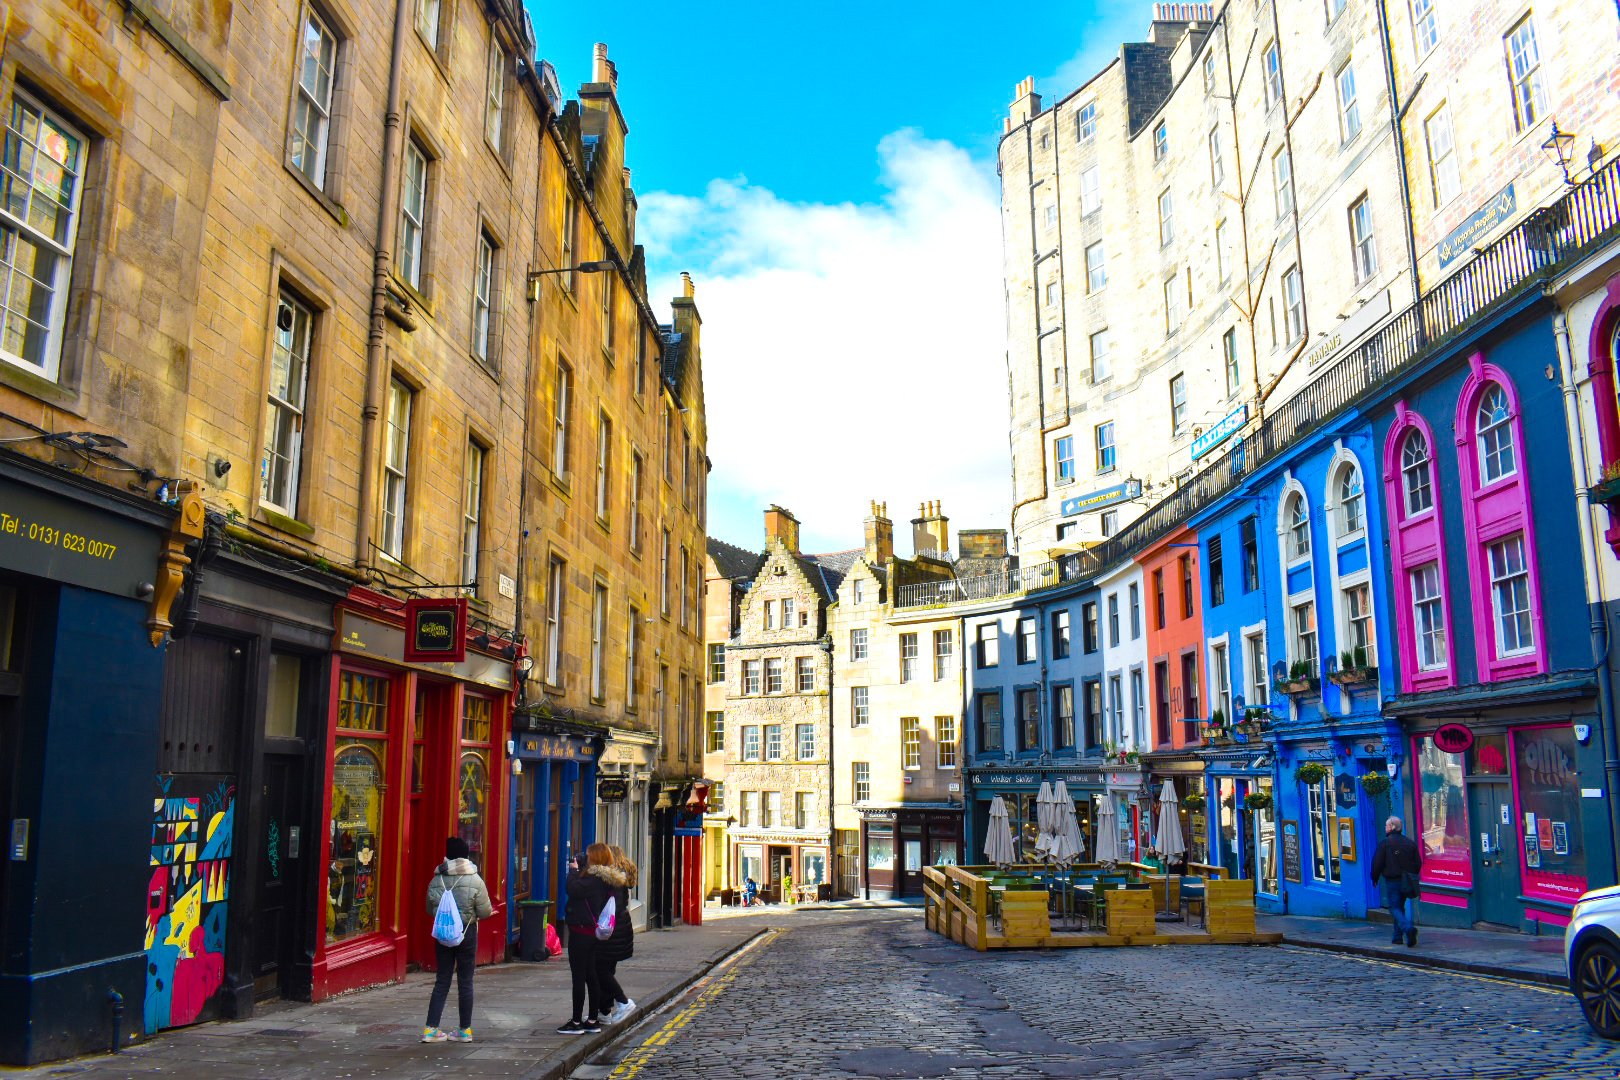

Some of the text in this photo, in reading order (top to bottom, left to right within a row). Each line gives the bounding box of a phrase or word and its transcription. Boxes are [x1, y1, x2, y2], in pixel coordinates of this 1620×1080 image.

[1454, 226, 1475, 247] Victoria
[1, 513, 19, 534] Tel
[29, 523, 60, 546] 0131
[63, 533, 86, 553] 623
[87, 539, 117, 560] 0077
[1171, 686, 1183, 714] 40
